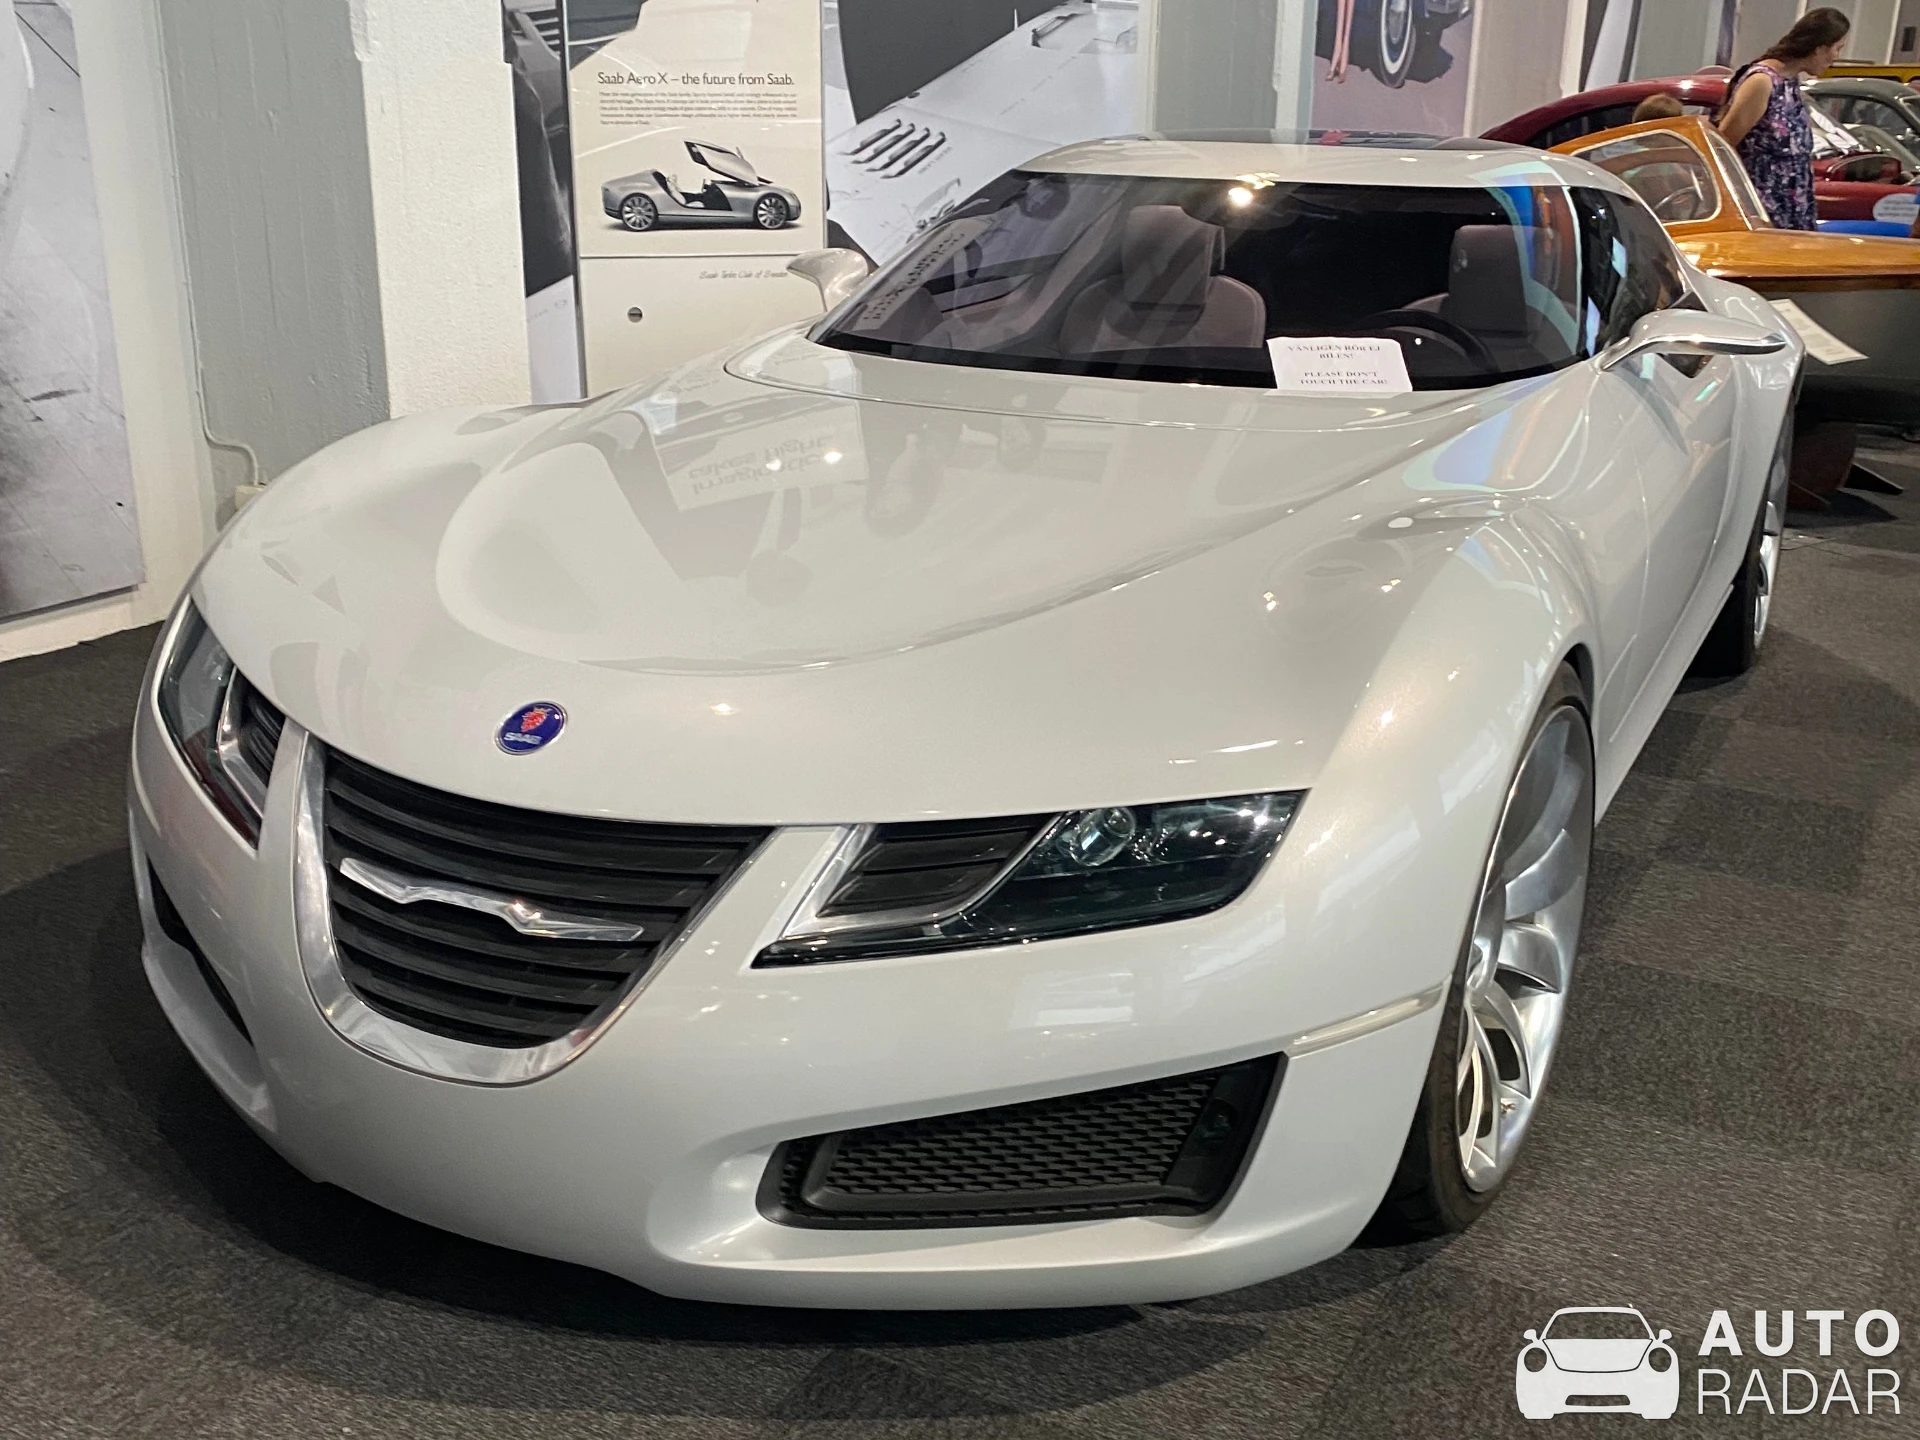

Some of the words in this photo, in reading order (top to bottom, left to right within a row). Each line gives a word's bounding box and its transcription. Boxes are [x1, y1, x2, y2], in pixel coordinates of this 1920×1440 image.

[598, 72, 624, 84] Saab
[626, 72, 656, 84] Aero
[657, 72, 669, 84] X
[681, 72, 700, 85] the
[702, 72, 736, 85] future
[738, 73, 765, 85] from
[767, 73, 795, 85] Saab.
[503, 732, 542, 745] SAAB
